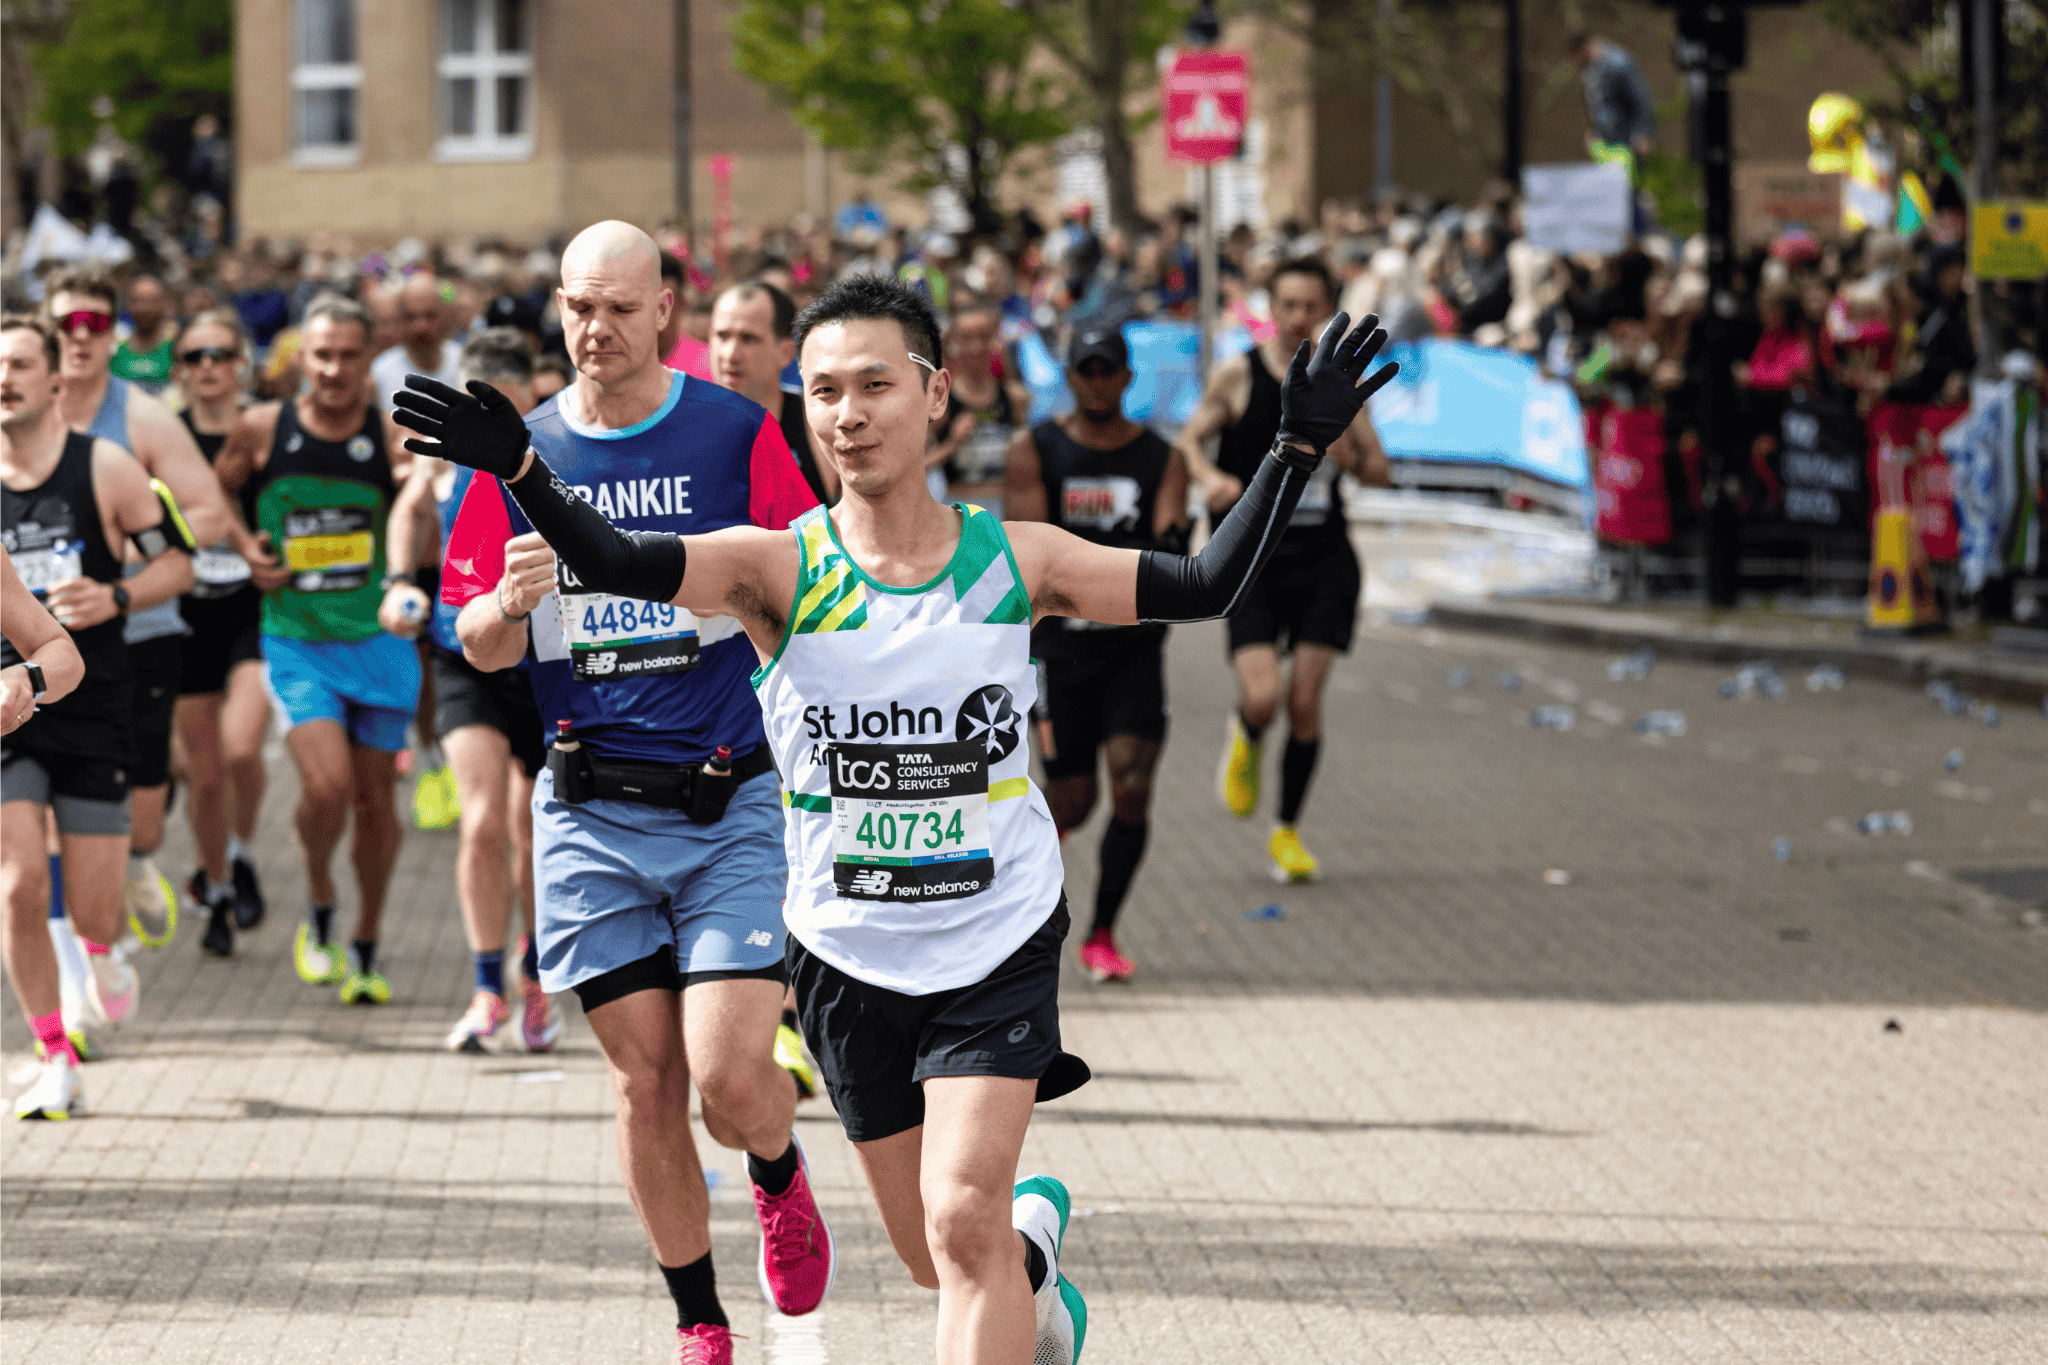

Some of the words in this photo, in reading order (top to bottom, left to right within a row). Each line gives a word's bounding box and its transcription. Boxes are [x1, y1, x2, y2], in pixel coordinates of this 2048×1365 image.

[582, 600, 675, 637] 44849
[619, 660, 643, 673] new
[643, 655, 689, 669] balance
[803, 705, 837, 740] St
[844, 700, 942, 739] John
[896, 753, 933, 764] TATA
[837, 752, 891, 790] tcs
[896, 761, 979, 778] CONSULTANCY
[897, 777, 950, 790] SERVICES
[856, 808, 965, 850] 40734
[893, 885, 921, 896] new
[924, 880, 980, 896] balance
